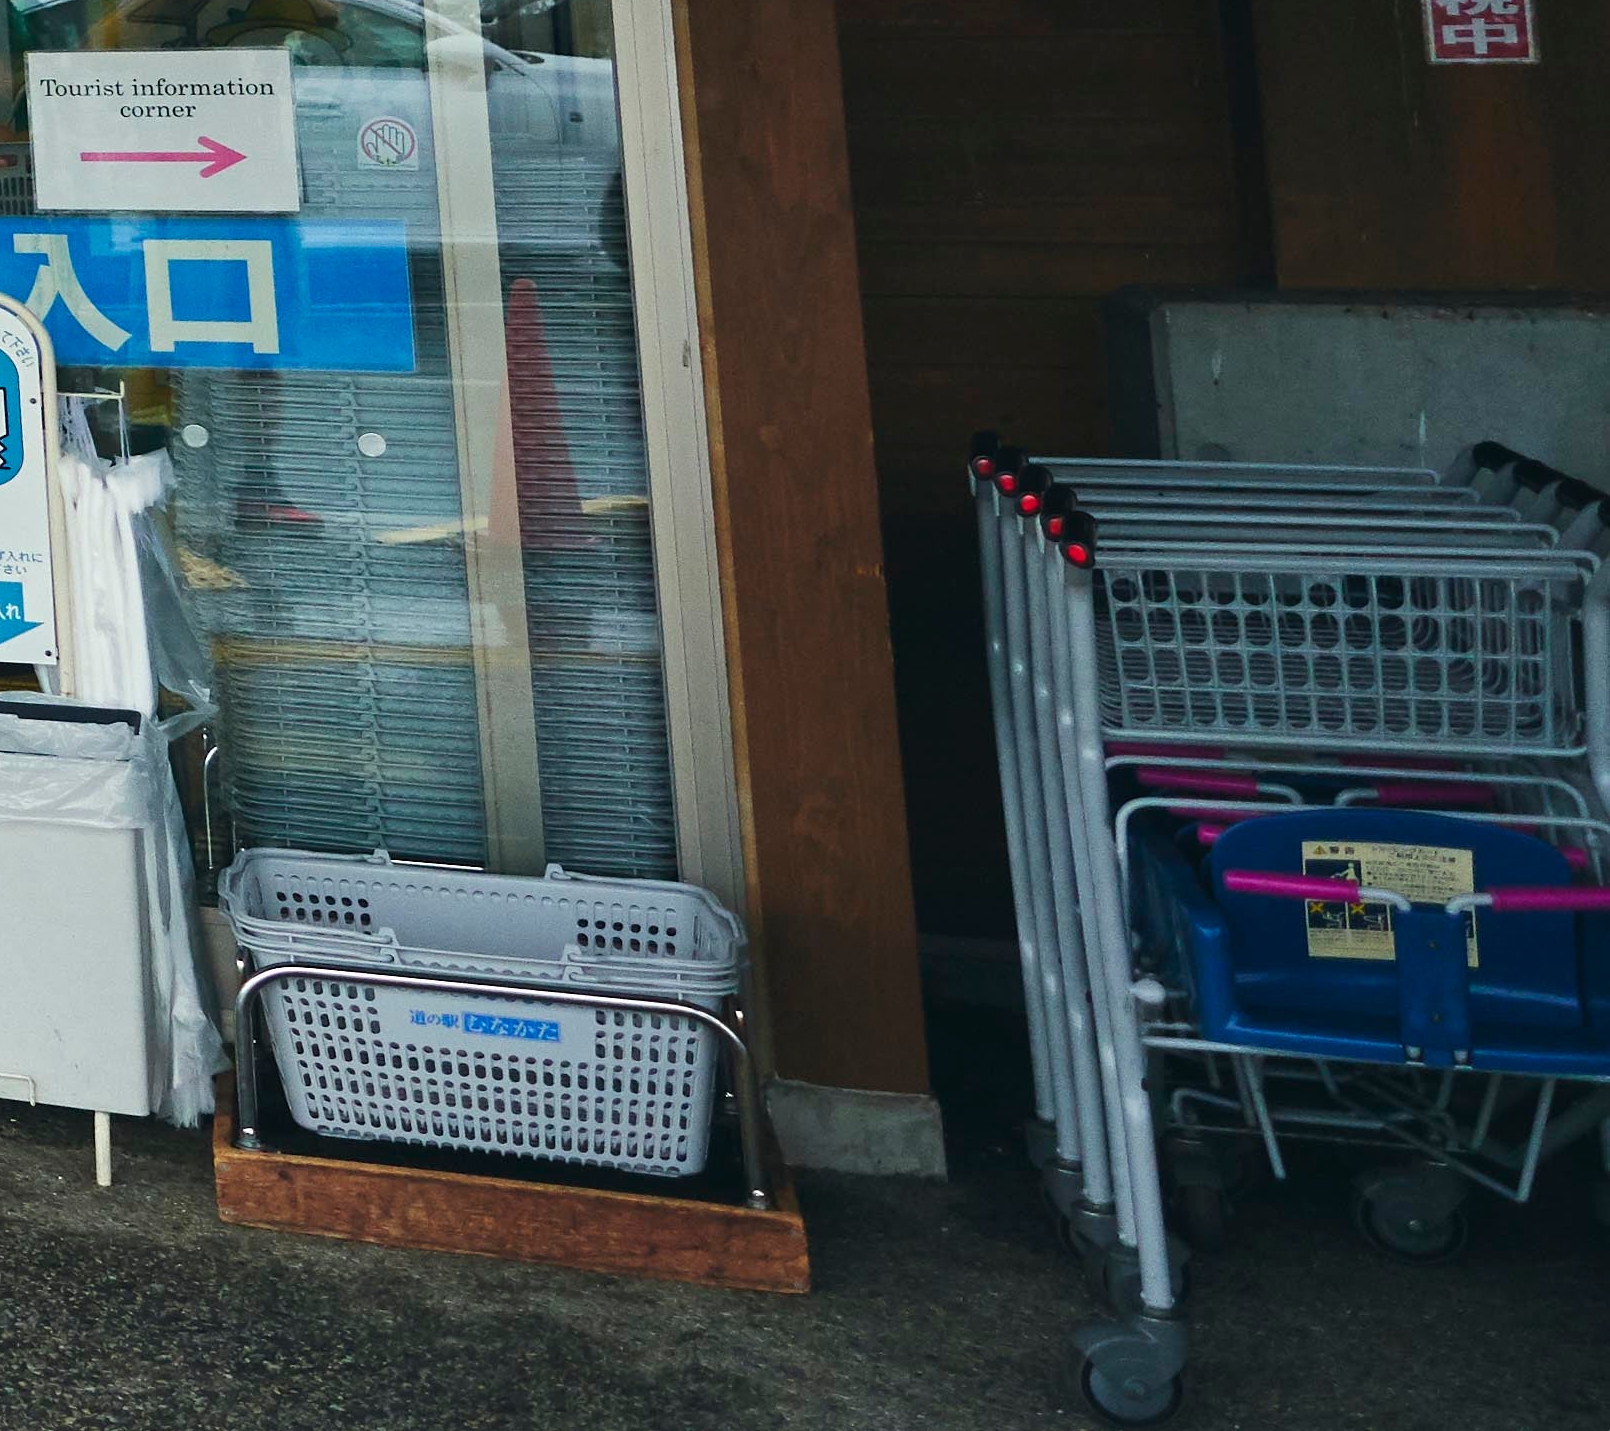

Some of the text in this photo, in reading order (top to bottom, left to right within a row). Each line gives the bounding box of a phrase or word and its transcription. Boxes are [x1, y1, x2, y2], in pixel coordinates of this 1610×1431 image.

[38, 75, 276, 101] Tourist information
[118, 99, 198, 119] corner
[410, 1008, 557, 1040] 道の駅 むなかた
